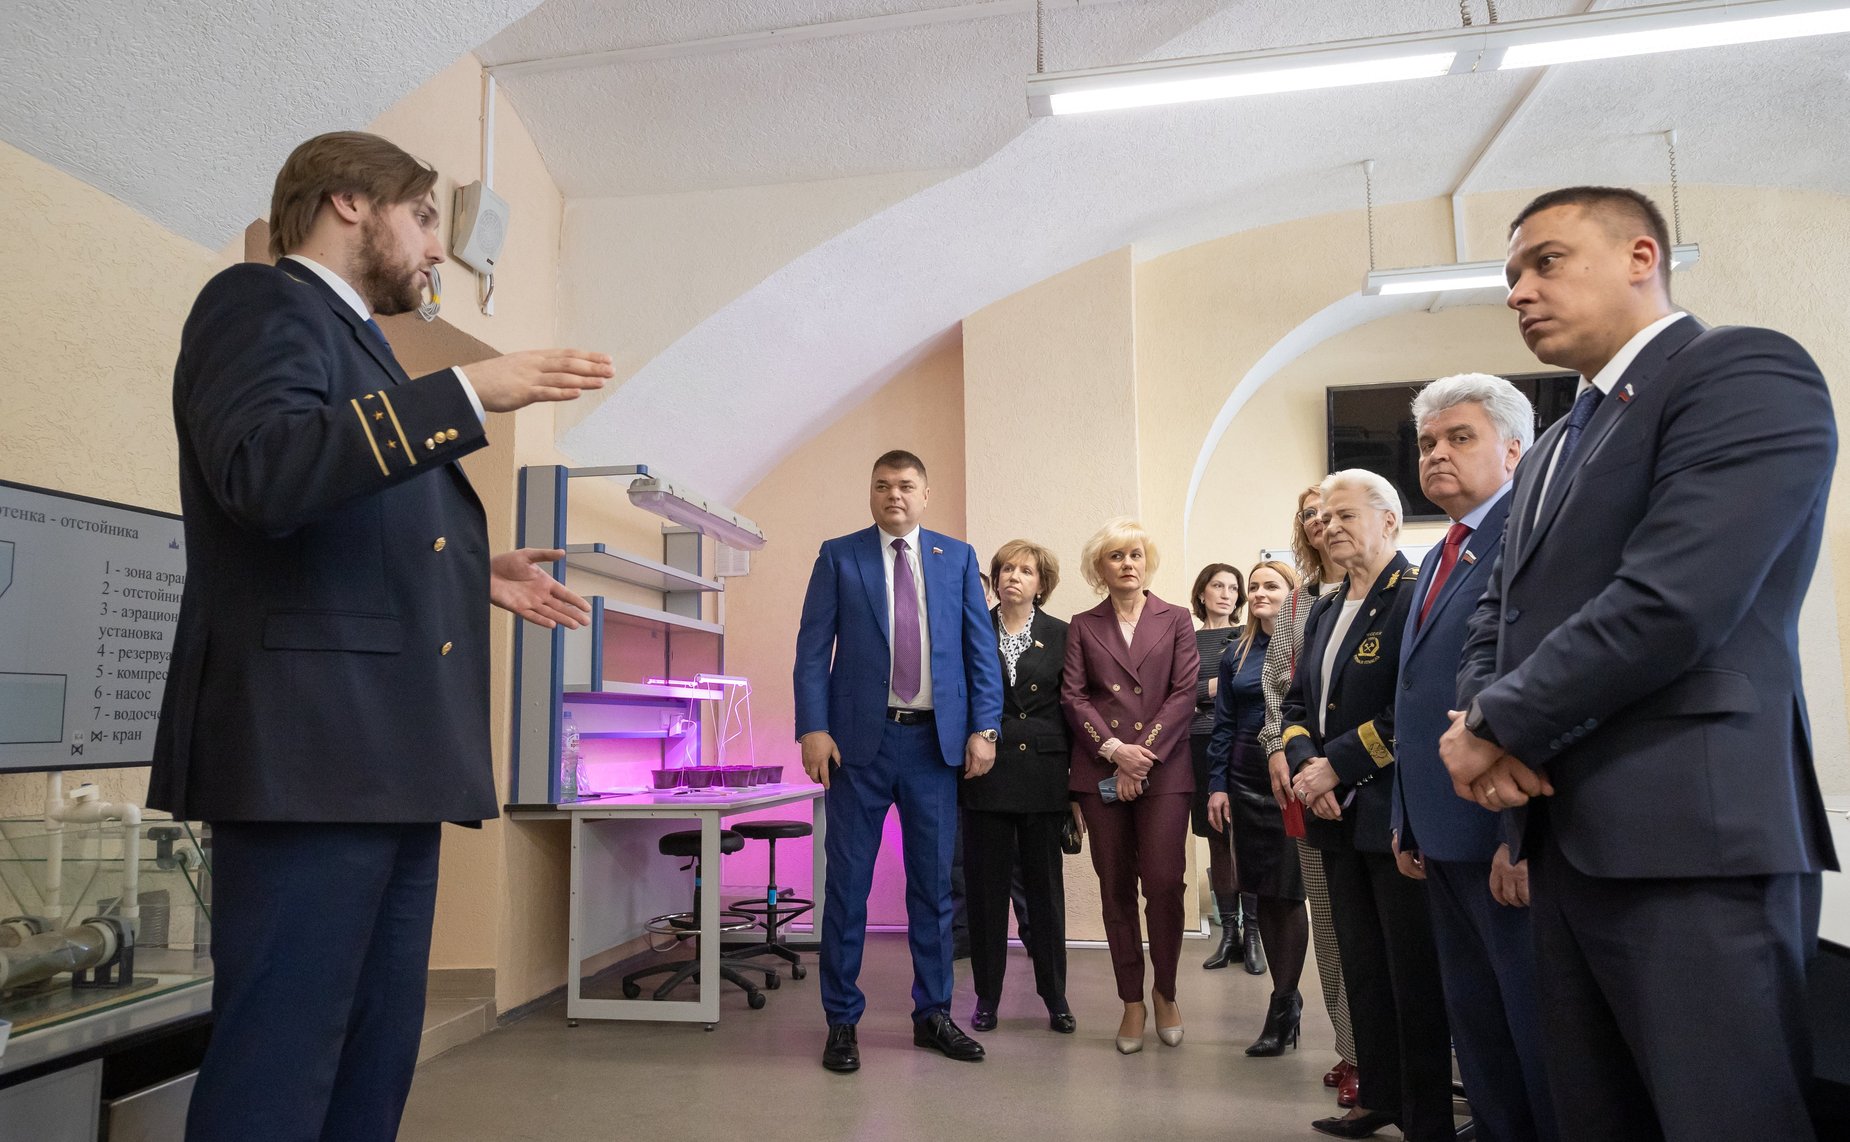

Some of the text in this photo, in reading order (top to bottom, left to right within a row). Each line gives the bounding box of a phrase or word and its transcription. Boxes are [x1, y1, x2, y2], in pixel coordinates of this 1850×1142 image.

[0, 506, 45, 523] тенка
[61, 516, 139, 539] отстойника
[105, 561, 109, 574] 1
[124, 567, 152, 580] зона
[102, 581, 109, 595] 2
[100, 602, 108, 615] 3
[121, 608, 178, 622] аэрацион
[99, 626, 163, 641] установка
[97, 644, 105, 657] 4
[96, 664, 104, 678] 5
[94, 685, 102, 699] 6
[115, 689, 151, 700] насос
[93, 706, 101, 720] 7
[112, 730, 142, 744] кран
